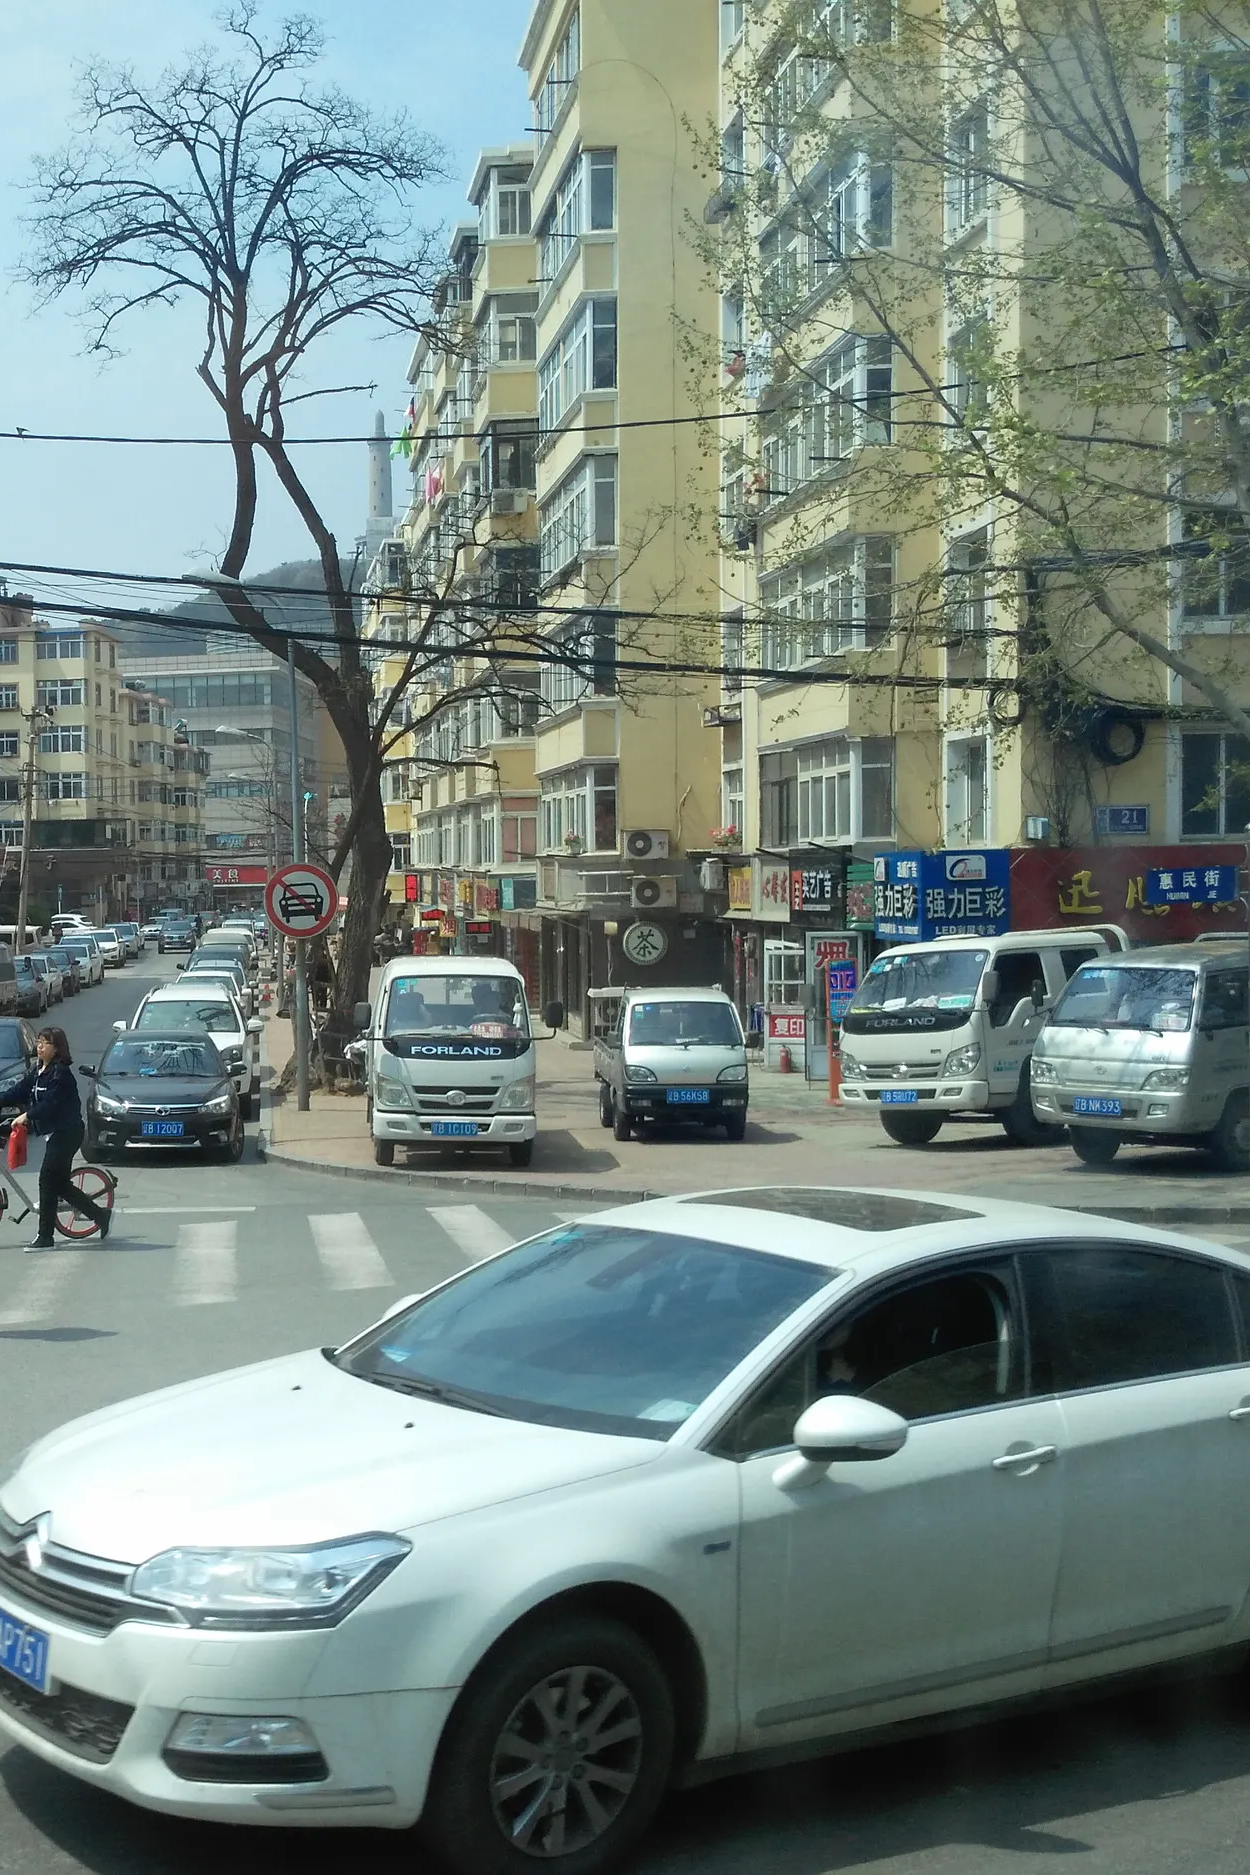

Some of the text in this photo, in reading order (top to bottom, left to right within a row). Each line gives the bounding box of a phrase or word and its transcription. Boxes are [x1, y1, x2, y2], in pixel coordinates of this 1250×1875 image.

[1121, 810, 1138, 824] 21
[802, 870, 832, 898] 实艺广告
[1158, 870, 1220, 889] 惠民街
[874, 883, 915, 919] 强力巨彩
[926, 886, 1006, 918] 强力巨彩
[632, 929, 660, 957] 茶
[774, 1018, 805, 1035] 复印
[866, 1017, 936, 1028] FORLAND
[411, 1046, 502, 1056] FORLAND
